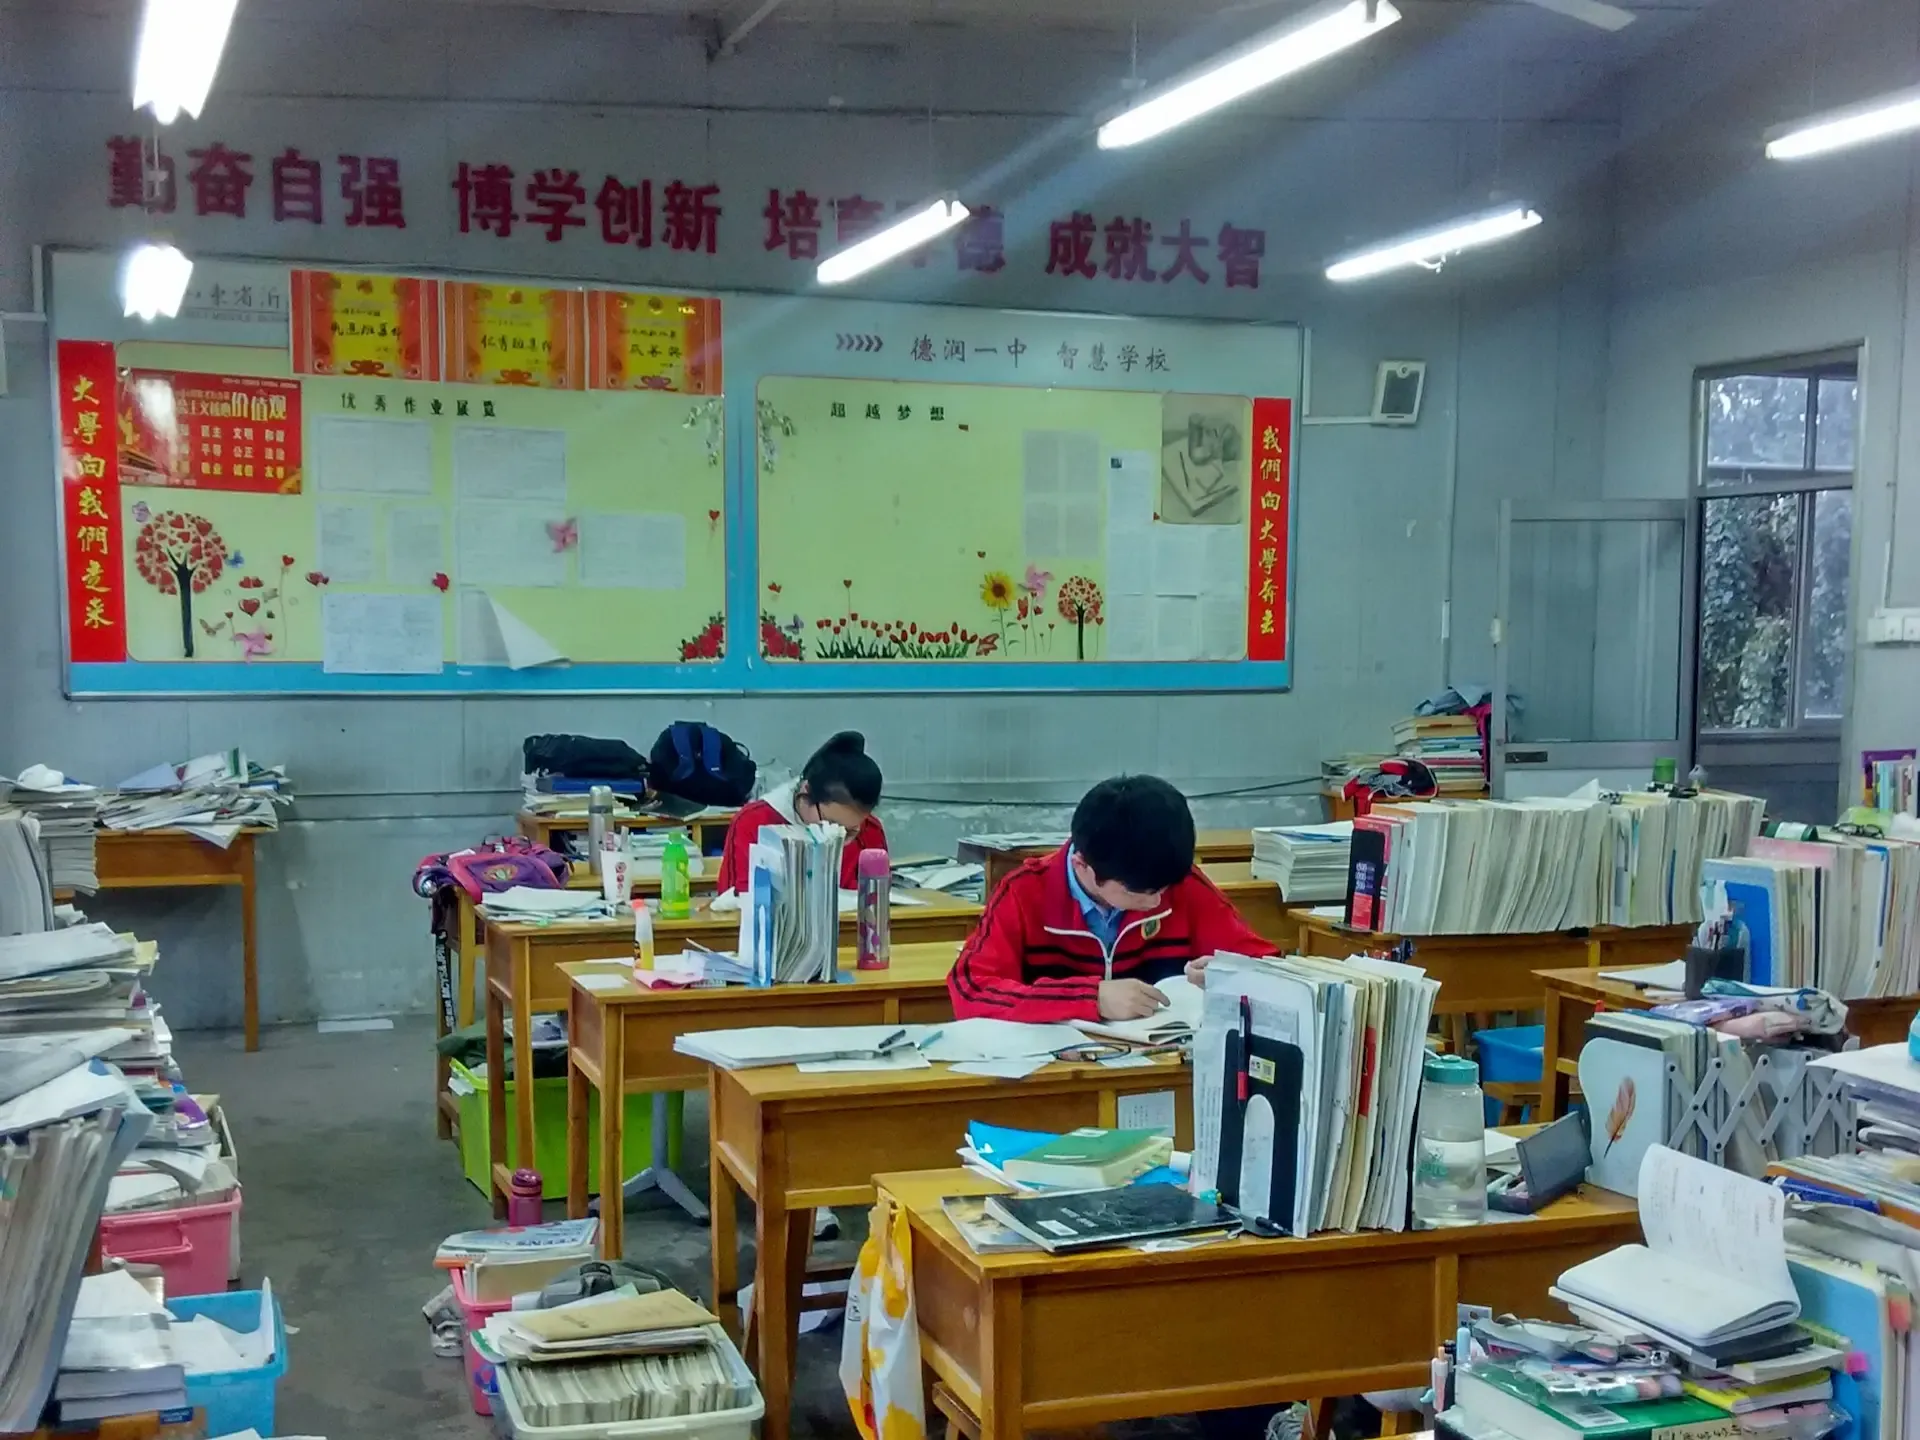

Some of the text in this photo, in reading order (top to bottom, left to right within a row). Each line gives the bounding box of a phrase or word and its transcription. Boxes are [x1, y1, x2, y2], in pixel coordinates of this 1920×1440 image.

[105, 135, 408, 230] 勤奋自强
[451, 160, 724, 256] 博学创新
[1044, 210, 1267, 290] 成就大智
[911, 334, 1171, 373] 德润一中 智慧学校
[341, 392, 496, 417] 优秀作业展览
[830, 402, 945, 421] 超越梦想
